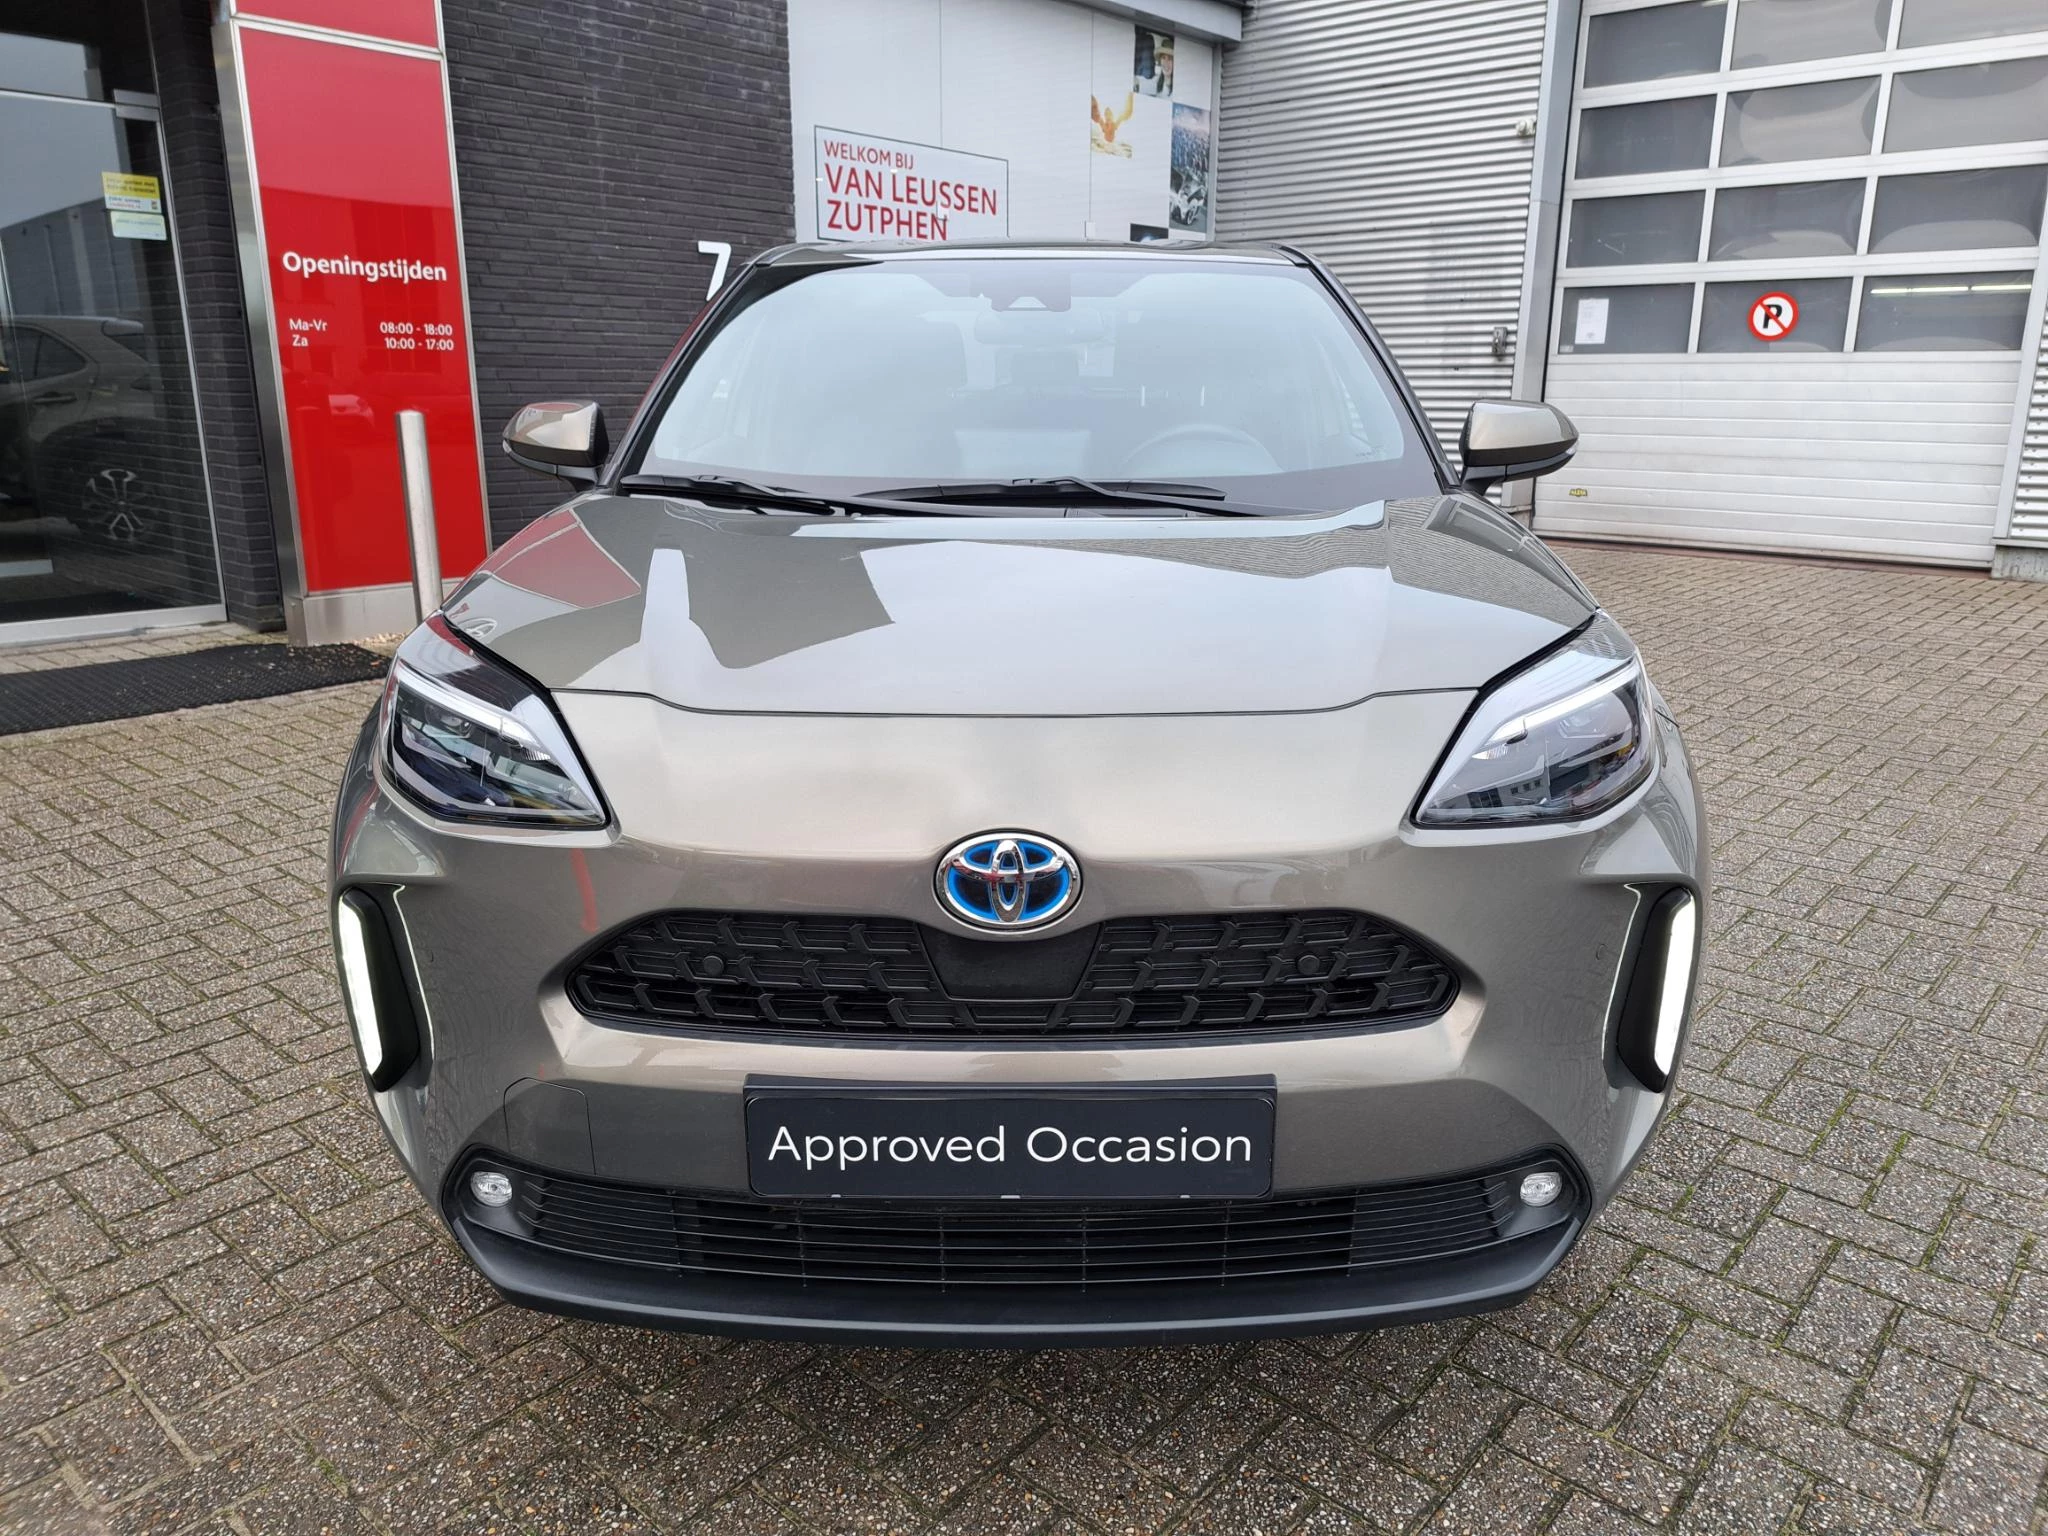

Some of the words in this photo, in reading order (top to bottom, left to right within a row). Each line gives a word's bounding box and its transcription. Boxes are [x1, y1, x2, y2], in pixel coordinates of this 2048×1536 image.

[824, 139, 891, 166] WELKOM
[895, 153, 914, 170] BIJ
[825, 162, 882, 200] VAN
[892, 171, 997, 216] LEUSSEN
[827, 199, 948, 241] ZUTPHEN
[282, 251, 447, 284] Openingstijden
[698, 240, 731, 302] 7
[289, 318, 328, 331] Ma-Vr
[379, 321, 414, 335] 08:00
[424, 323, 453, 336] 18:00
[292, 334, 309, 347] Za
[384, 337, 415, 349] 10:00
[426, 339, 454, 351] 17:00
[767, 1125, 1005, 1171] Approved
[1026, 1126, 1252, 1163] Occasion
